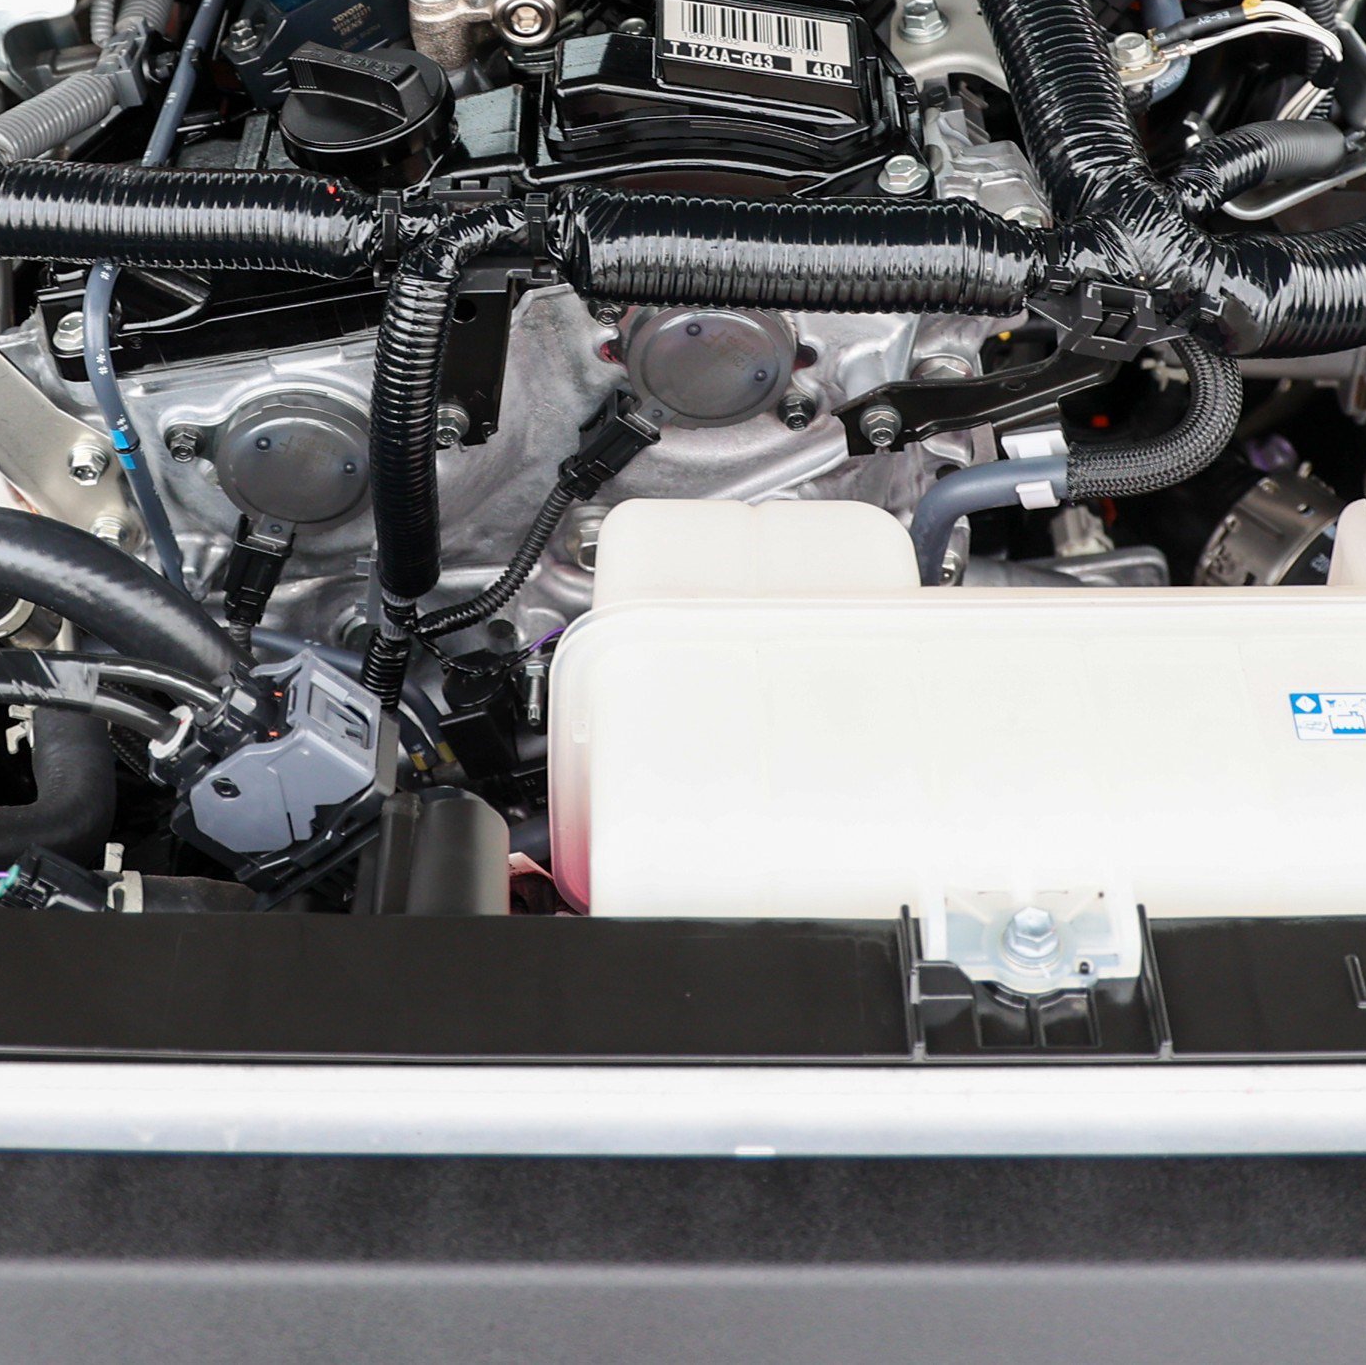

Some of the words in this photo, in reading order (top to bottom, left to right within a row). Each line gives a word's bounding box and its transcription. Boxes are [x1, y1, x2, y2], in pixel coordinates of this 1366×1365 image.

[670, 41, 681, 55] T
[688, 43, 774, 69] T24A-G43
[812, 62, 844, 80] 460
